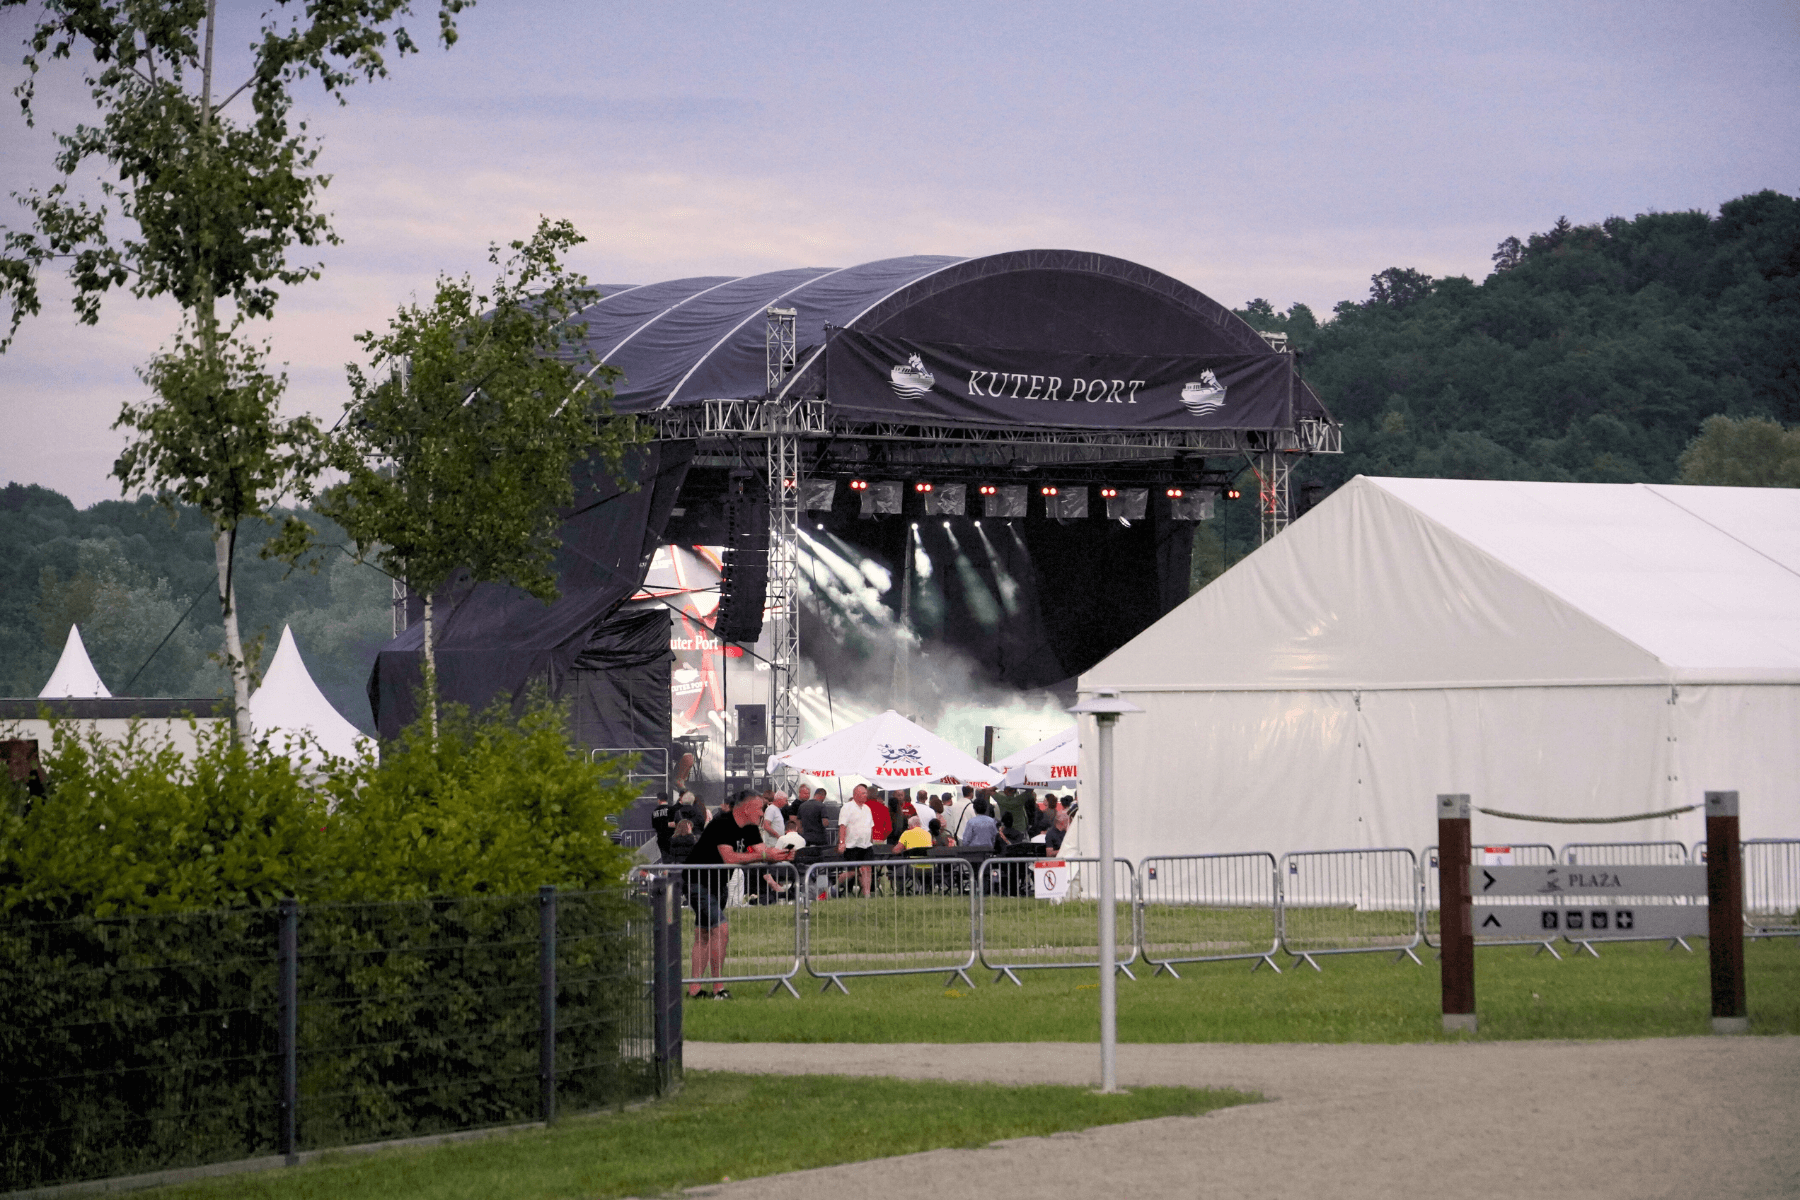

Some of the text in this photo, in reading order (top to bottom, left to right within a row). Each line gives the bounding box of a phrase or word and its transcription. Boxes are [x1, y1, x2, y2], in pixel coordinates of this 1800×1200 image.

[968, 370, 1146, 404] KUTER PORT
[671, 634, 719, 650] uter Port
[875, 766, 932, 777] ŻYWIEC
[1050, 765, 1078, 779] ŻYWI
